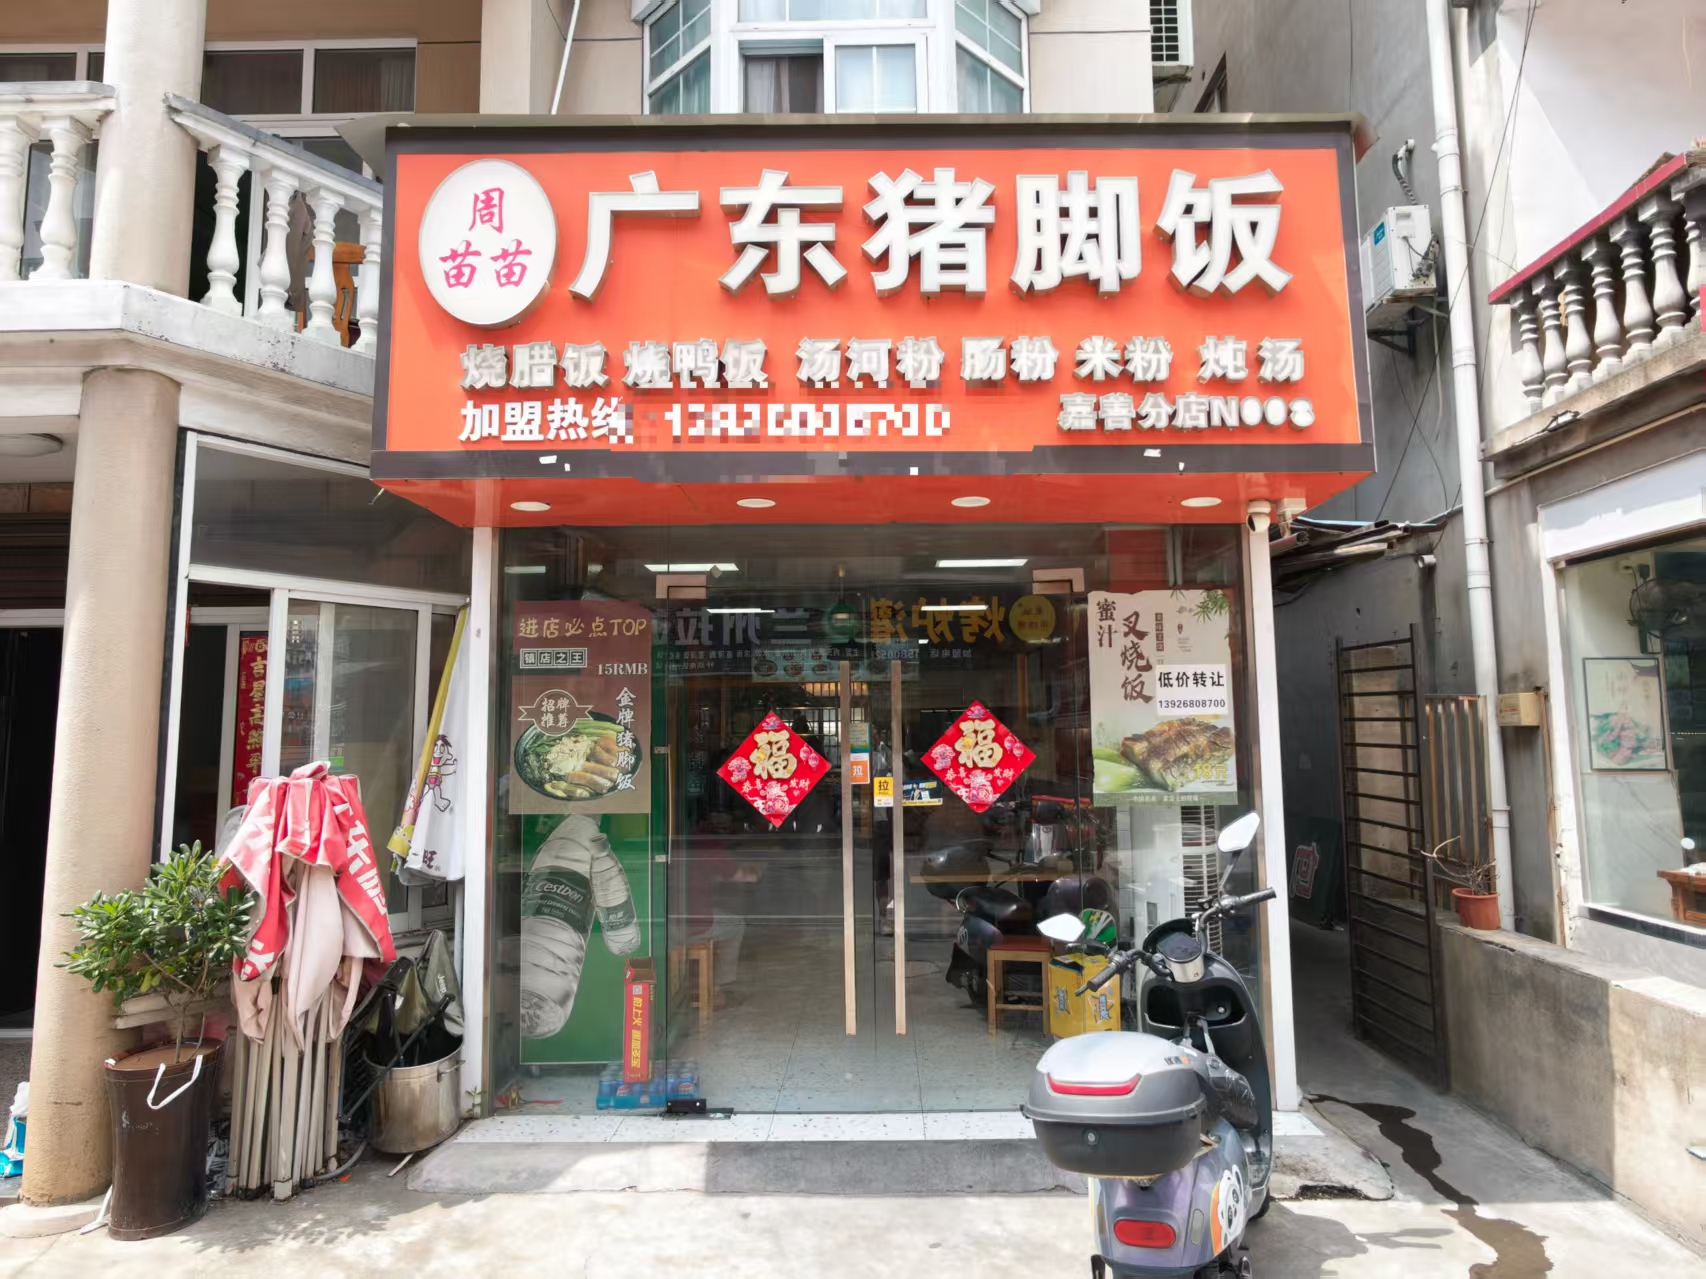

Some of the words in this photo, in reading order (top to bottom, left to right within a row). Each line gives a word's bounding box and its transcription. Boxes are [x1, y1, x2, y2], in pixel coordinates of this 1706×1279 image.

[468, 186, 505, 235] 周
[568, 168, 1293, 301] 广东猪脚饭
[438, 238, 533, 290] 苗苗
[459, 341, 609, 391] 烧腊饭
[621, 338, 769, 389] 烧鸭饭
[796, 335, 945, 388] 汤河粉
[960, 335, 1059, 383] 肠粉
[1073, 335, 1173, 382] 米粉
[1196, 336, 1305, 384] 炖汤
[1096, 597, 1118, 649] 蜜汁
[523, 651, 586, 666] 镇店之王
[1120, 609, 1155, 705] 叉烧饭
[597, 663, 649, 677] 15RMB
[1158, 671, 1226, 689] 低价转让
[541, 697, 571, 713] 招牌
[1158, 699, 1226, 709] 13926808700
[540, 712, 570, 729] 推荐
[614, 686, 637, 791] 金牌猪脚饭
[954, 719, 1004, 769] 福
[749, 729, 798, 780] 福
[741, 777, 764, 793] 恭喜
[789, 778, 811, 791] 发财
[877, 779, 890, 792] 拉
[422, 849, 438, 870] 旺
[437, 973, 448, 995] Jeep
